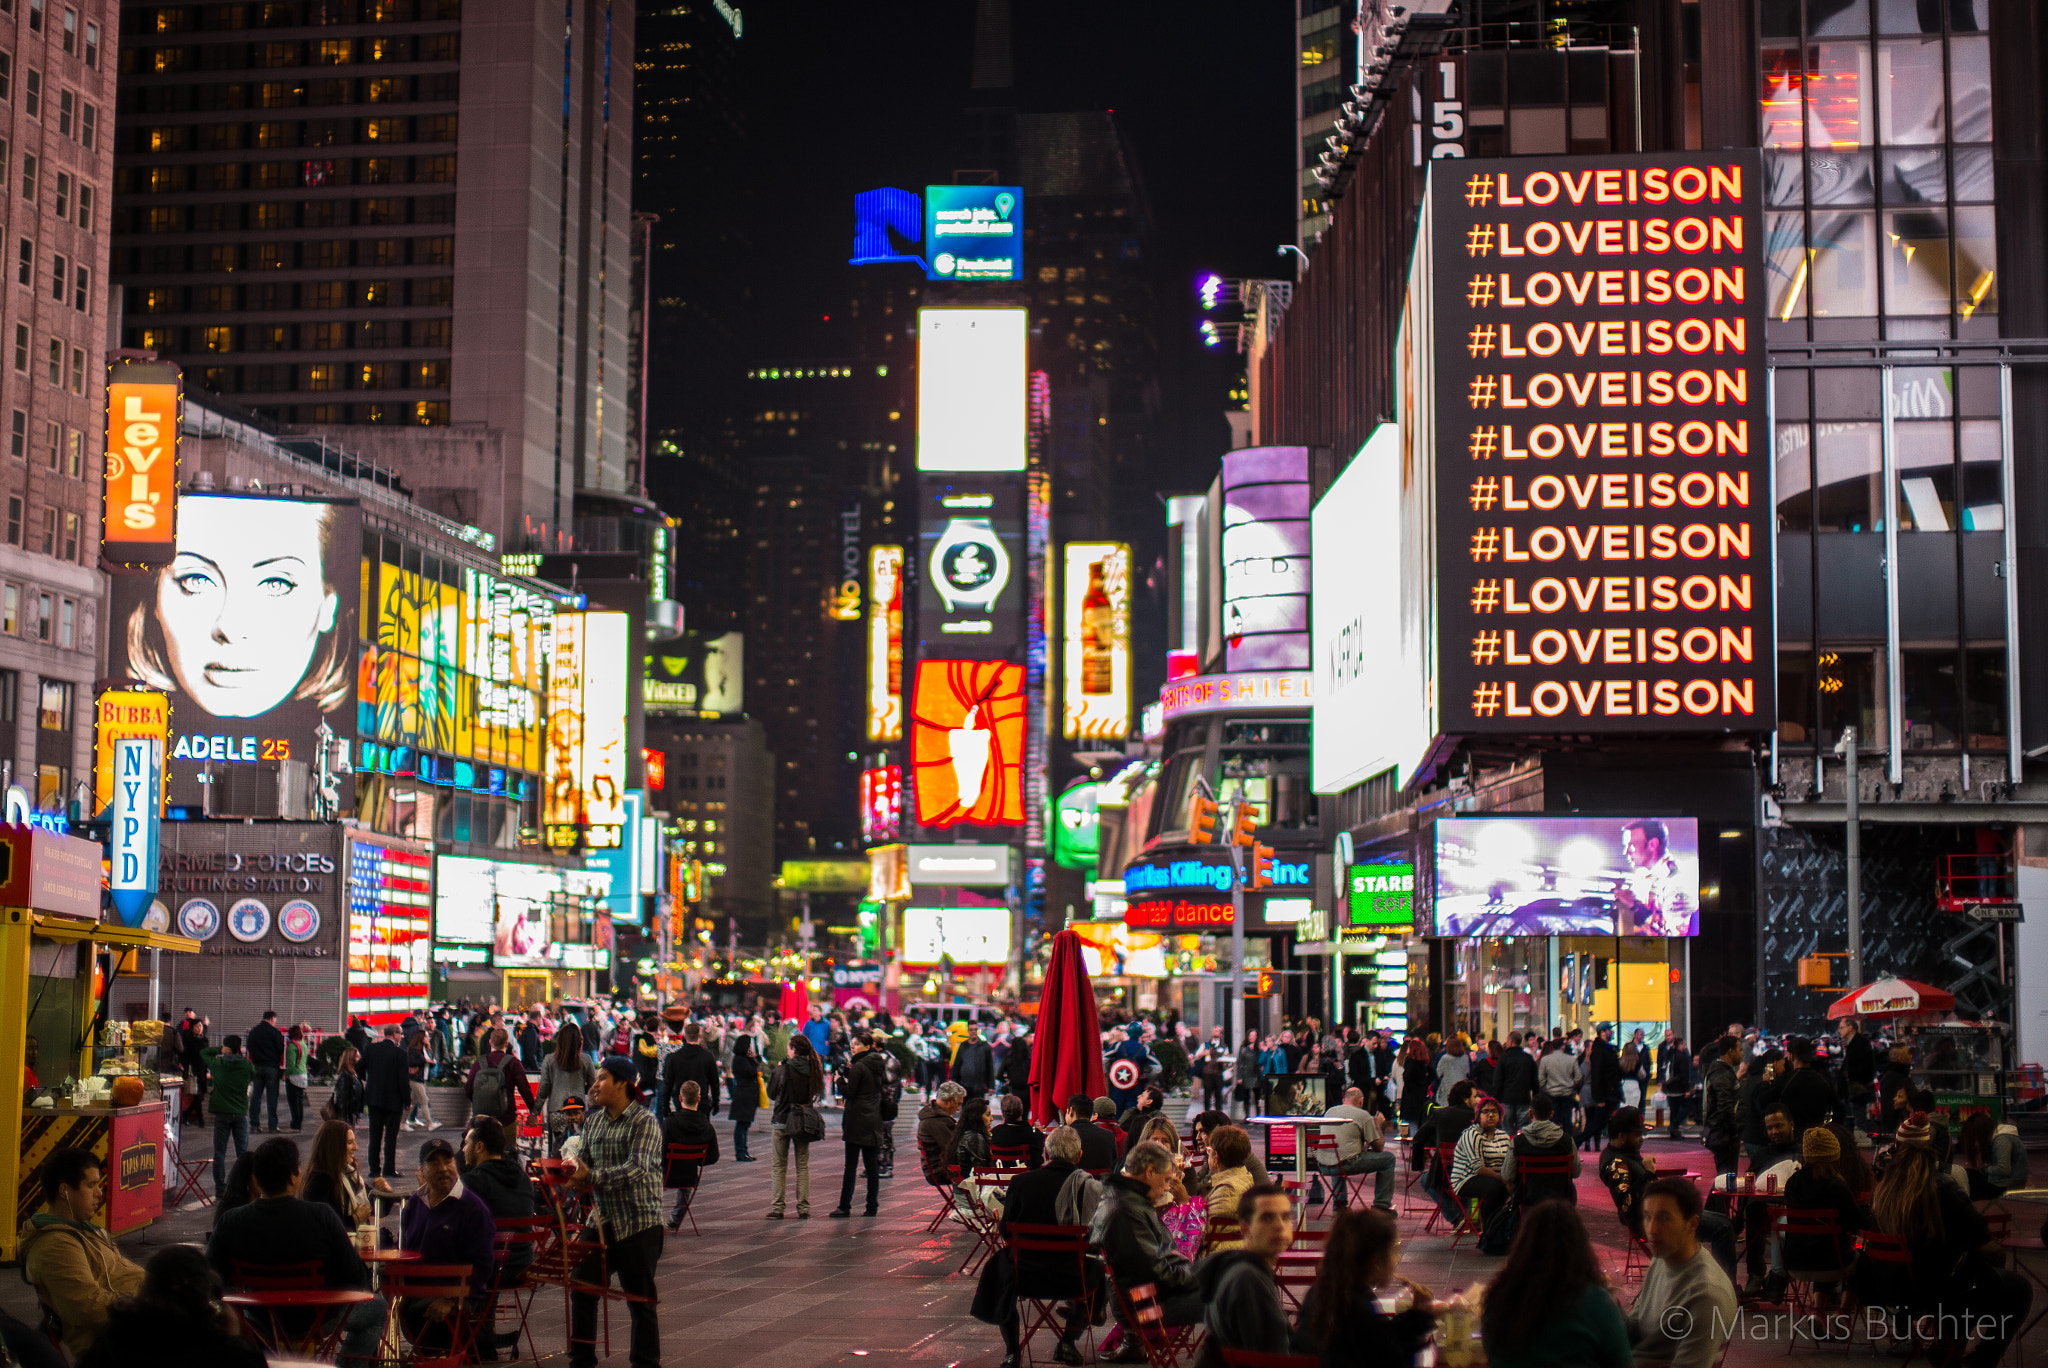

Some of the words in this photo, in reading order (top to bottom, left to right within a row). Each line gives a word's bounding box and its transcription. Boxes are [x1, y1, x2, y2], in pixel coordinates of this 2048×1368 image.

[1465, 165, 1742, 207] #LOVEISON
[1466, 215, 1743, 257] #LOVEISON
[1466, 266, 1745, 308] #LOVEISON
[1467, 317, 1746, 358] #LOVEISON
[1468, 368, 1747, 409] #LOVEISON
[1469, 419, 1748, 460] #LOVEISON
[1469, 471, 1749, 511] #LOVEISON
[838, 503, 862, 620] NOVOTEL
[1470, 522, 1751, 562] #LOVEISON
[1471, 574, 1752, 613] #LOVEISON
[1471, 626, 1753, 665] #LOVEISON
[1193, 681, 1214, 704] OF
[1472, 678, 1754, 717] #LOVEISON
[103, 702, 163, 725] BUBBA
[173, 735, 257, 761] ADELE
[261, 739, 290, 761] 25
[121, 745, 143, 883] NYPD
[159, 853, 242, 872] ARMED
[245, 853, 336, 874] FORCES
[244, 876, 323, 893] STATION
[1175, 901, 1235, 924] dance
[1974, 909, 1994, 917] ONE
[1997, 908, 2016, 916] WAY
[1861, 999, 1884, 1011] NUTS
[1891, 997, 1915, 1009] NUTS
